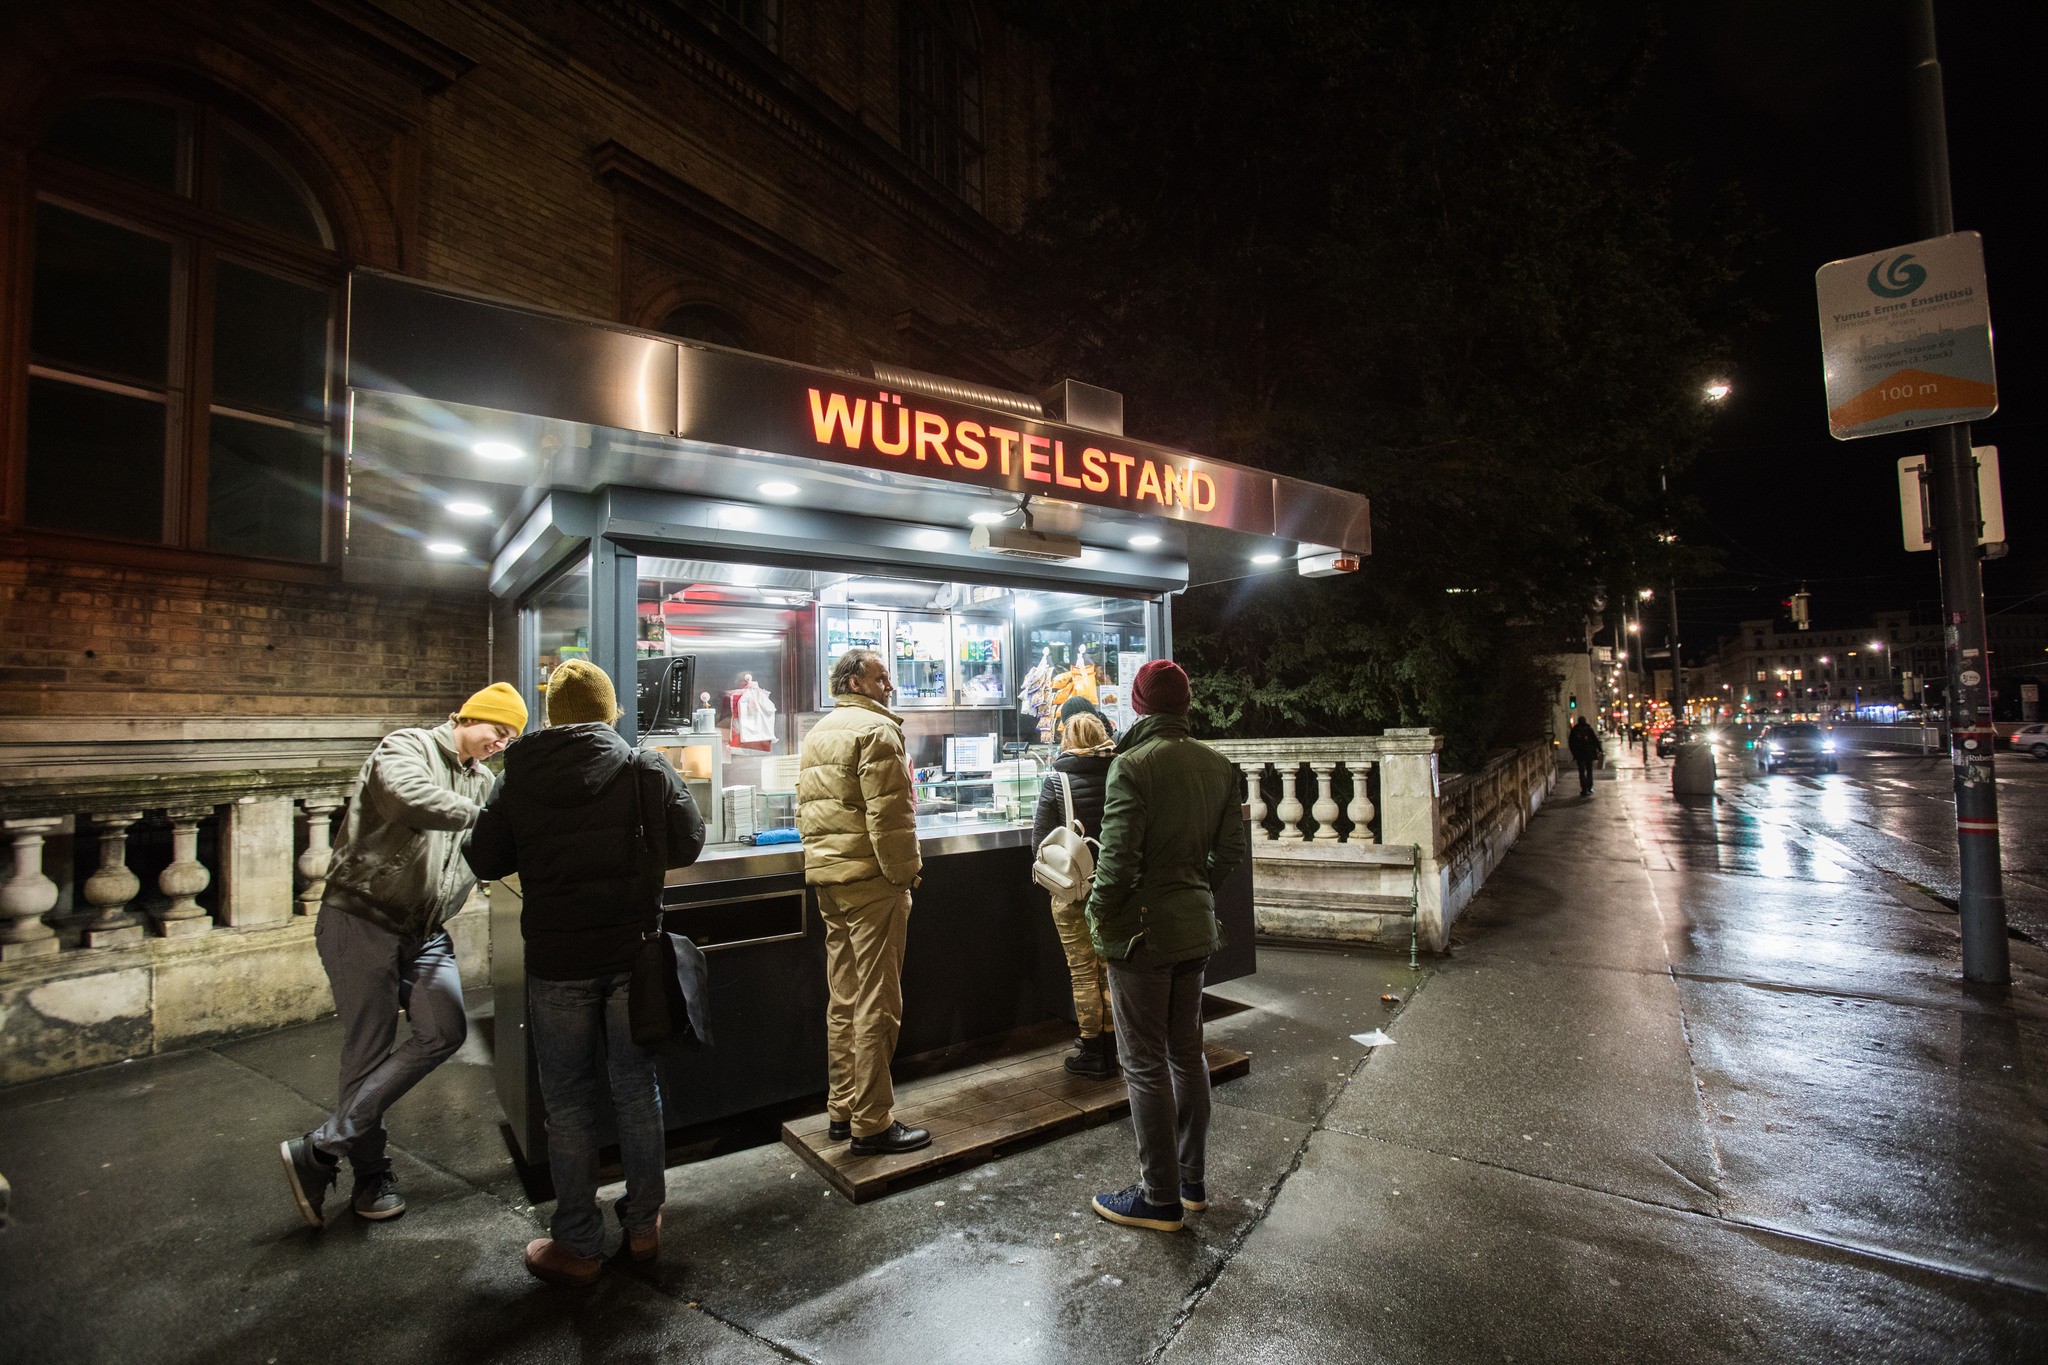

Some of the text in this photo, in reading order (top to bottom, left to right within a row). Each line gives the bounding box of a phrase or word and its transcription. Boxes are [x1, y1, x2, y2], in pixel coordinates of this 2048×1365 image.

[1833, 287, 1973, 323] Yunus Emre Enstitüsü
[1861, 363, 1882, 372] 1090
[1883, 359, 1907, 368] Wien
[1880, 383, 1938, 401] 100 m
[807, 387, 1217, 513] WÜRSTELSTAND
